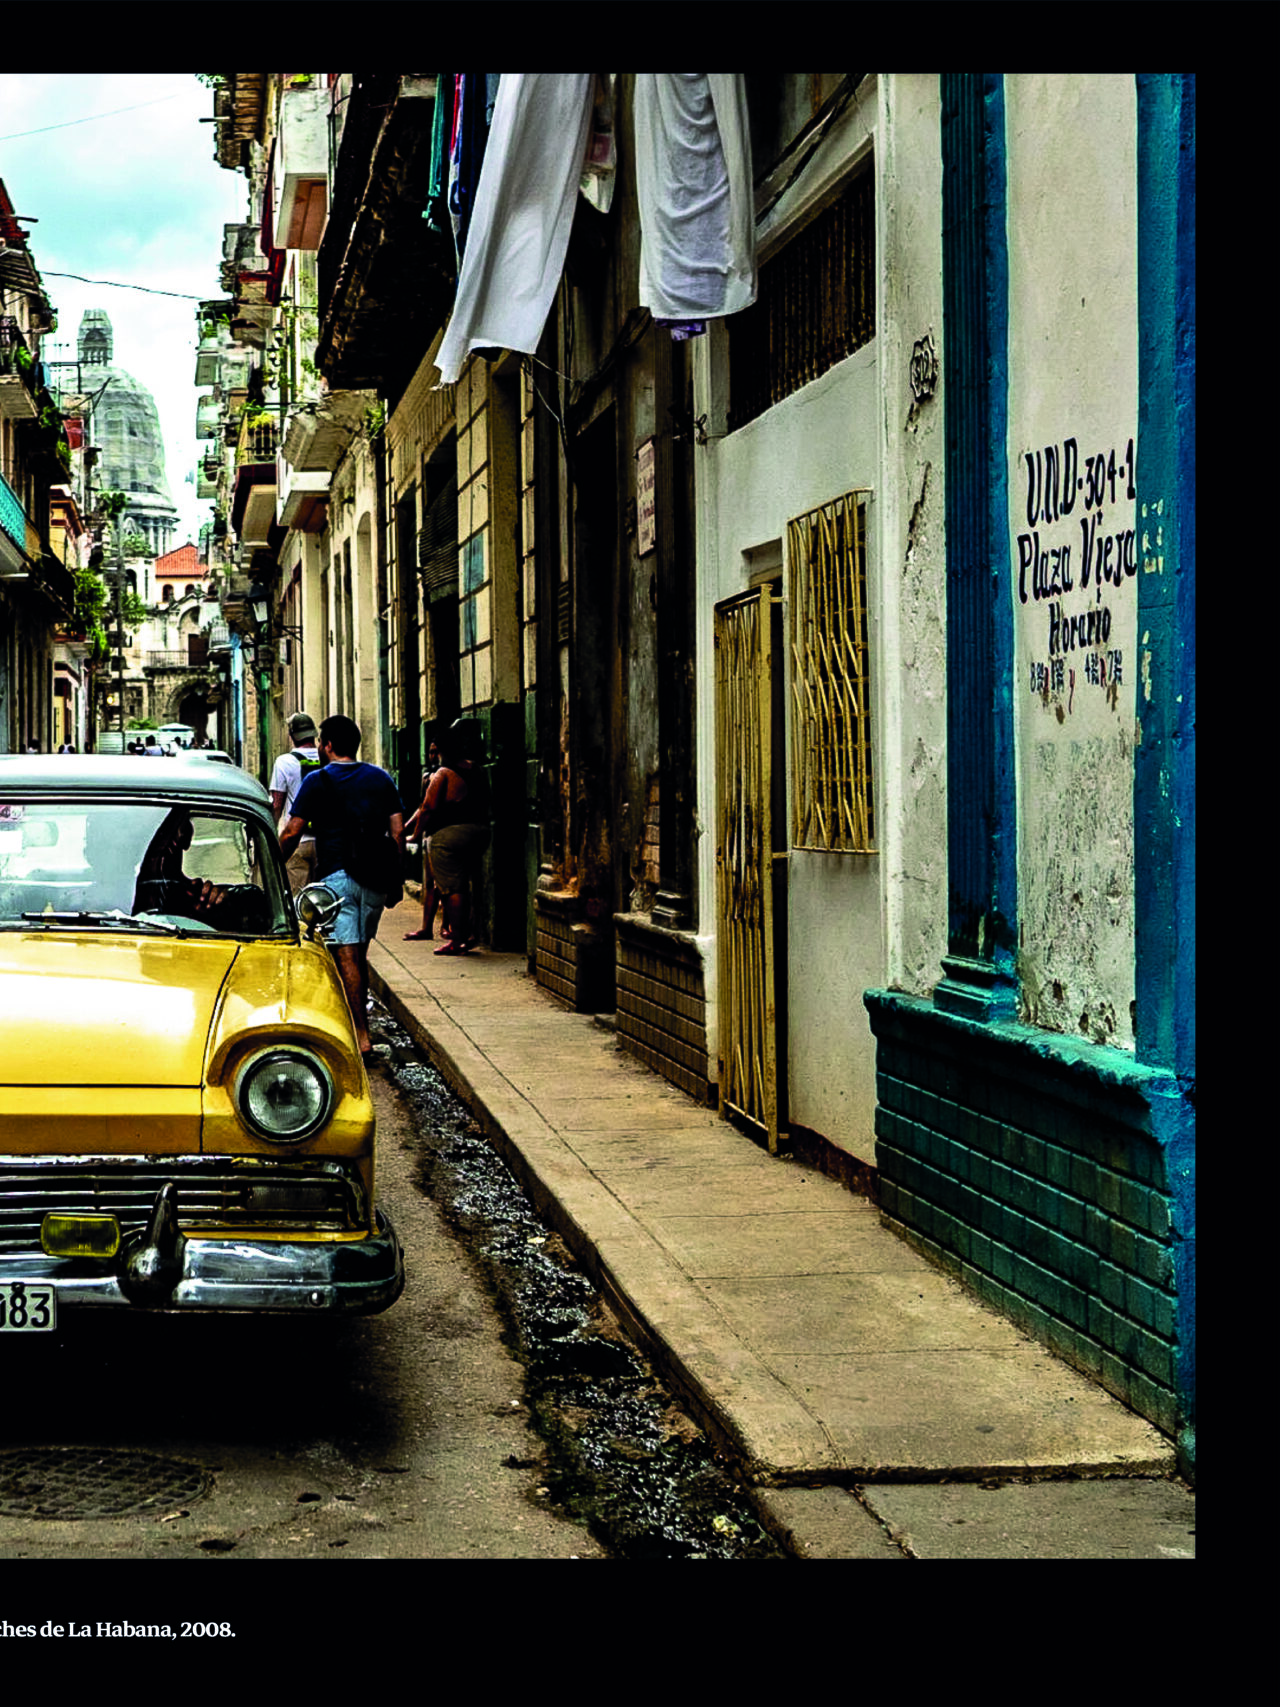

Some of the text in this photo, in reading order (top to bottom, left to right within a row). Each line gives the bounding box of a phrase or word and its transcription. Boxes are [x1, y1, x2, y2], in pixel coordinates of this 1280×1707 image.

[1017, 509, 1138, 604] Plaza Vieja
[1048, 592, 1111, 656] Horario
